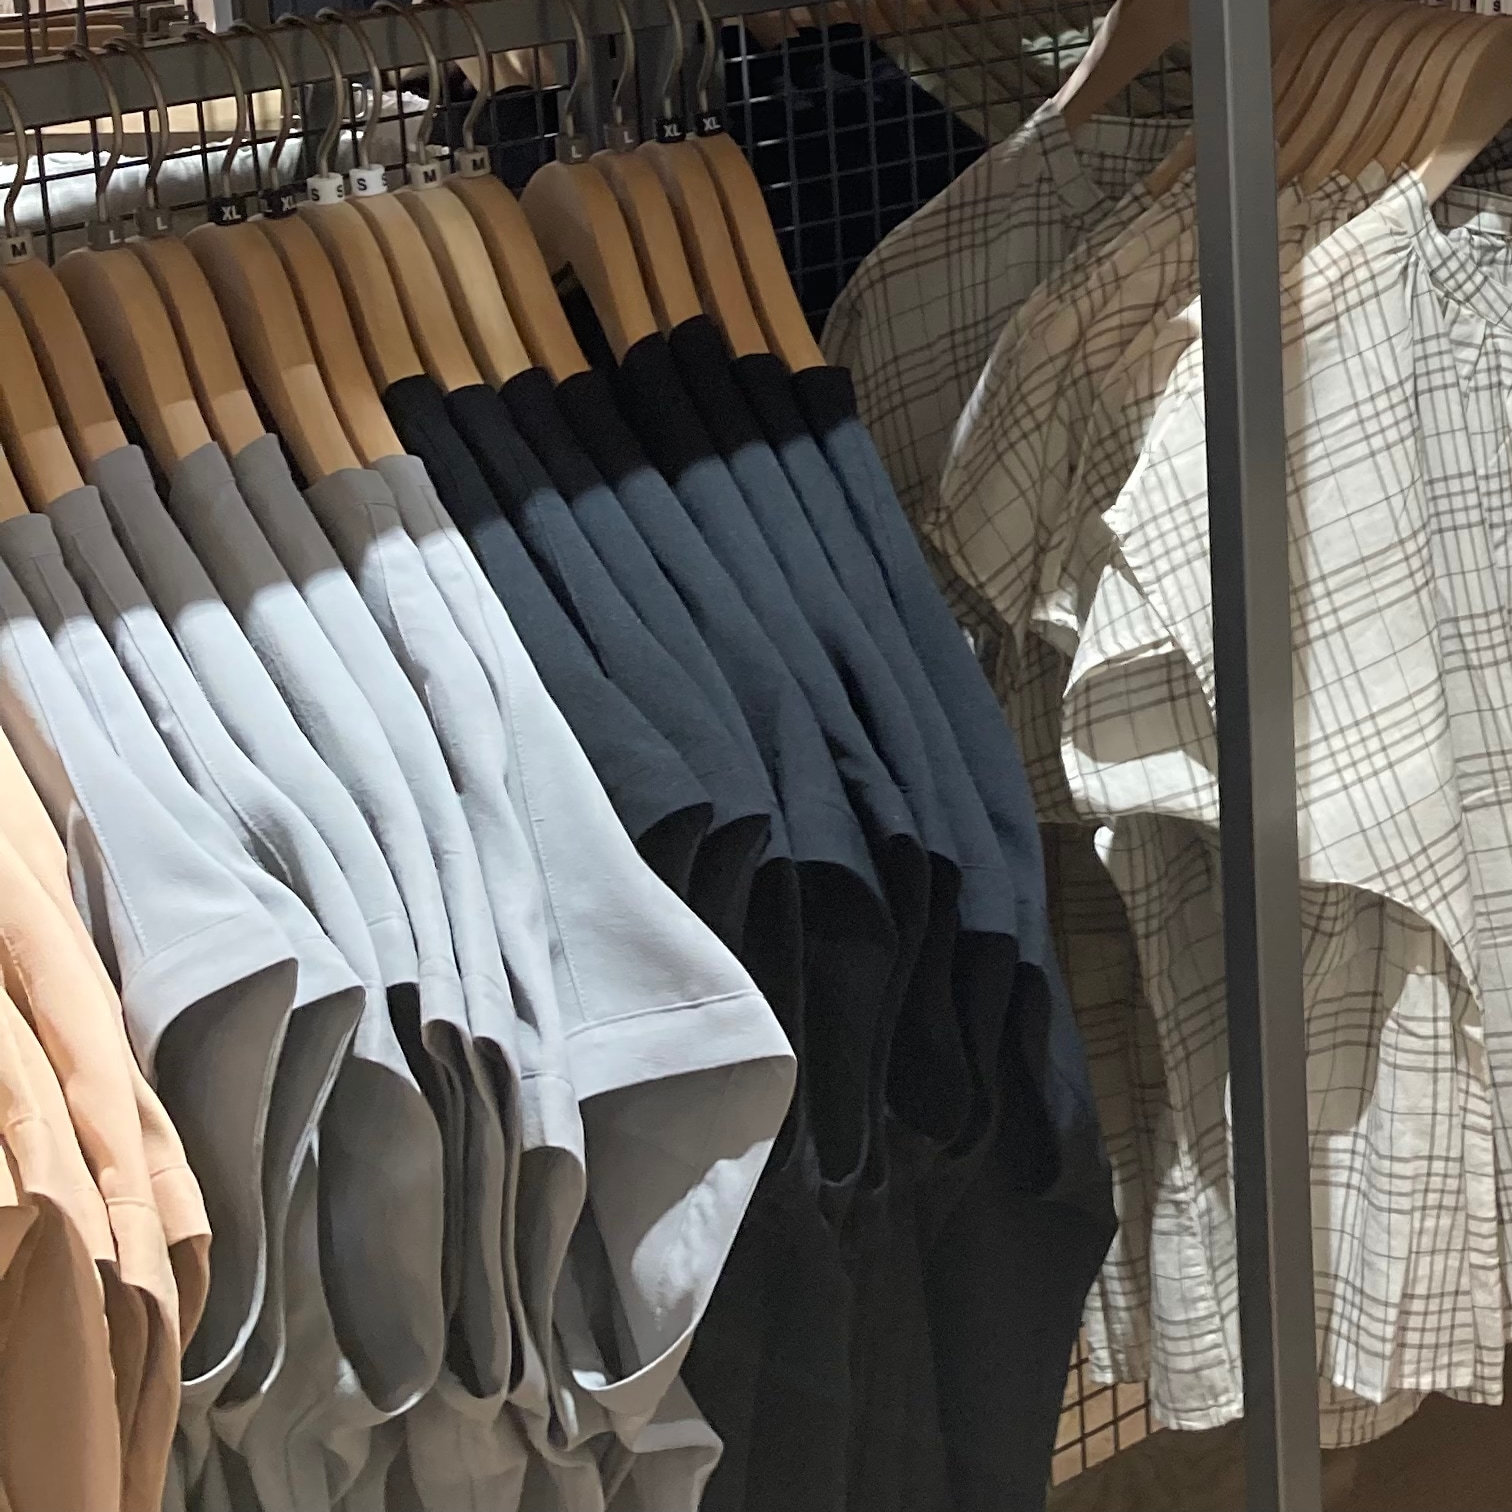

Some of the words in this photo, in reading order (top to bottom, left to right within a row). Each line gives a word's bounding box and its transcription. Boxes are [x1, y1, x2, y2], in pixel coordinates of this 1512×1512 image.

[1493, 0, 1501, 12] S
[663, 123, 682, 139] XL
[703, 115, 722, 131] XL
[623, 130, 634, 145] L
[571, 144, 583, 160] L
[472, 156, 486, 172] M
[356, 177, 368, 192] S
[422, 168, 437, 185] M
[311, 188, 321, 202] S
[336, 184, 344, 199] S
[280, 194, 299, 212] XL
[221, 205, 242, 222] XL
[155, 215, 169, 231] L
[109, 229, 121, 245] L
[11, 241, 28, 258] M
